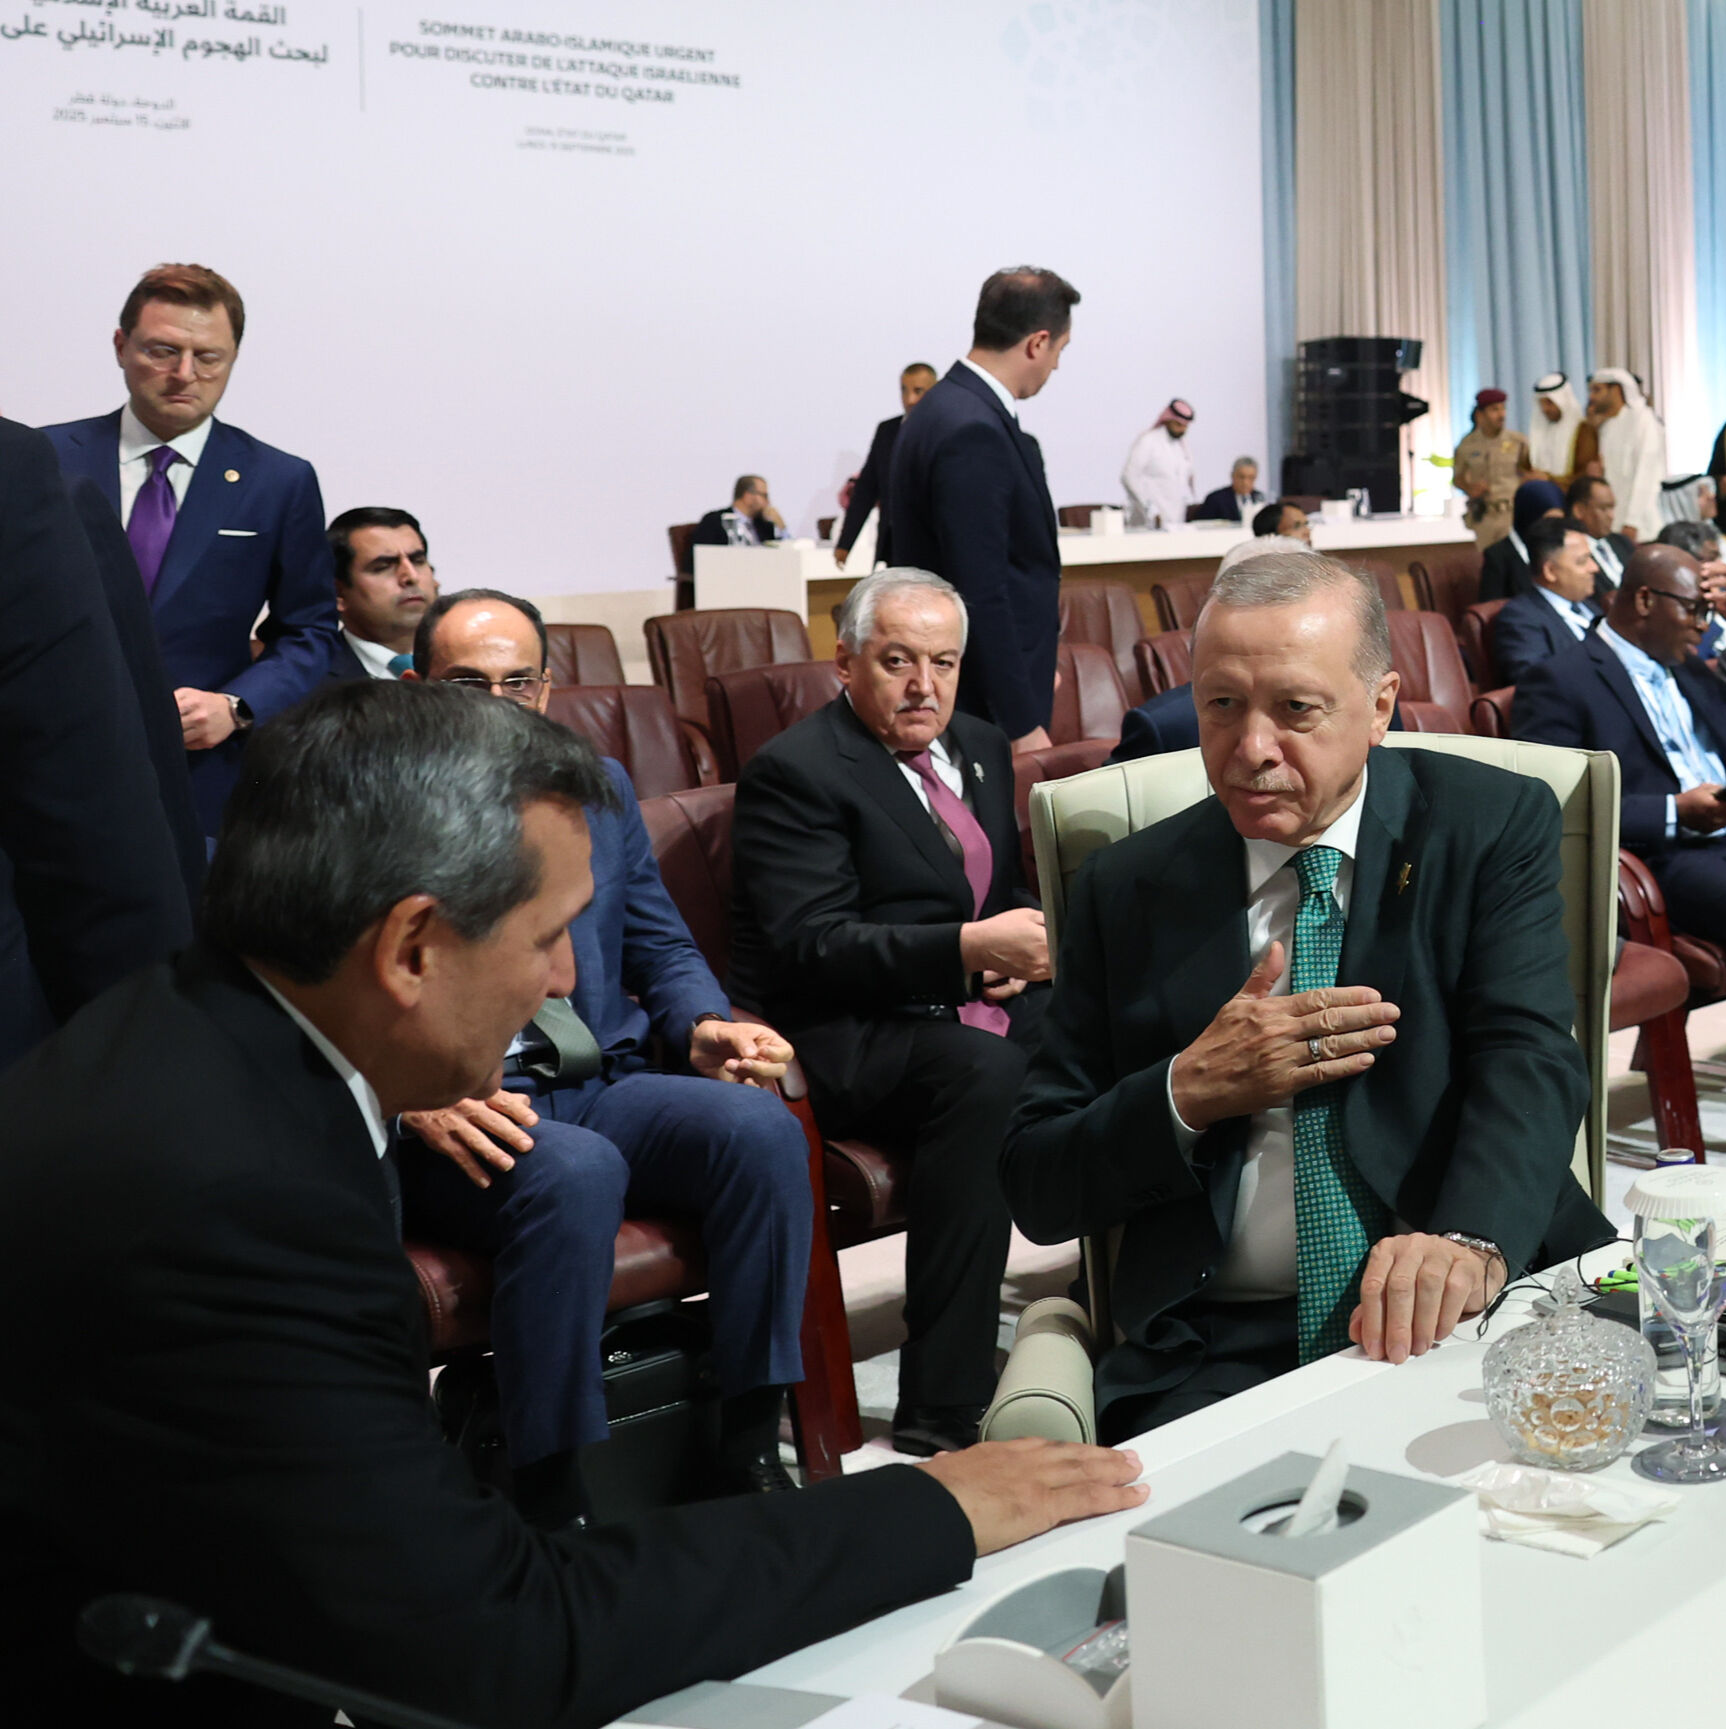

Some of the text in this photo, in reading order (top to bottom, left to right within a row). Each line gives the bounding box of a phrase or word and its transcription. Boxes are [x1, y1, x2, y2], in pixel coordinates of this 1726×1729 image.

[224, 0, 286, 25] القمة
[0, 14, 328, 69] لبحث الهجوم الإسرائيلي على
[389, 40, 440, 59] POUR
[444, 46, 527, 67] DISCUTER
[531, 54, 553, 70] DE
[556, 57, 640, 80] L'ATTAQUE
[418, 19, 496, 41] SOMMET
[653, 45, 715, 63] URGENT
[470, 72, 538, 93] CONTRE
[594, 83, 618, 99] DU
[621, 85, 676, 104] QATAR
